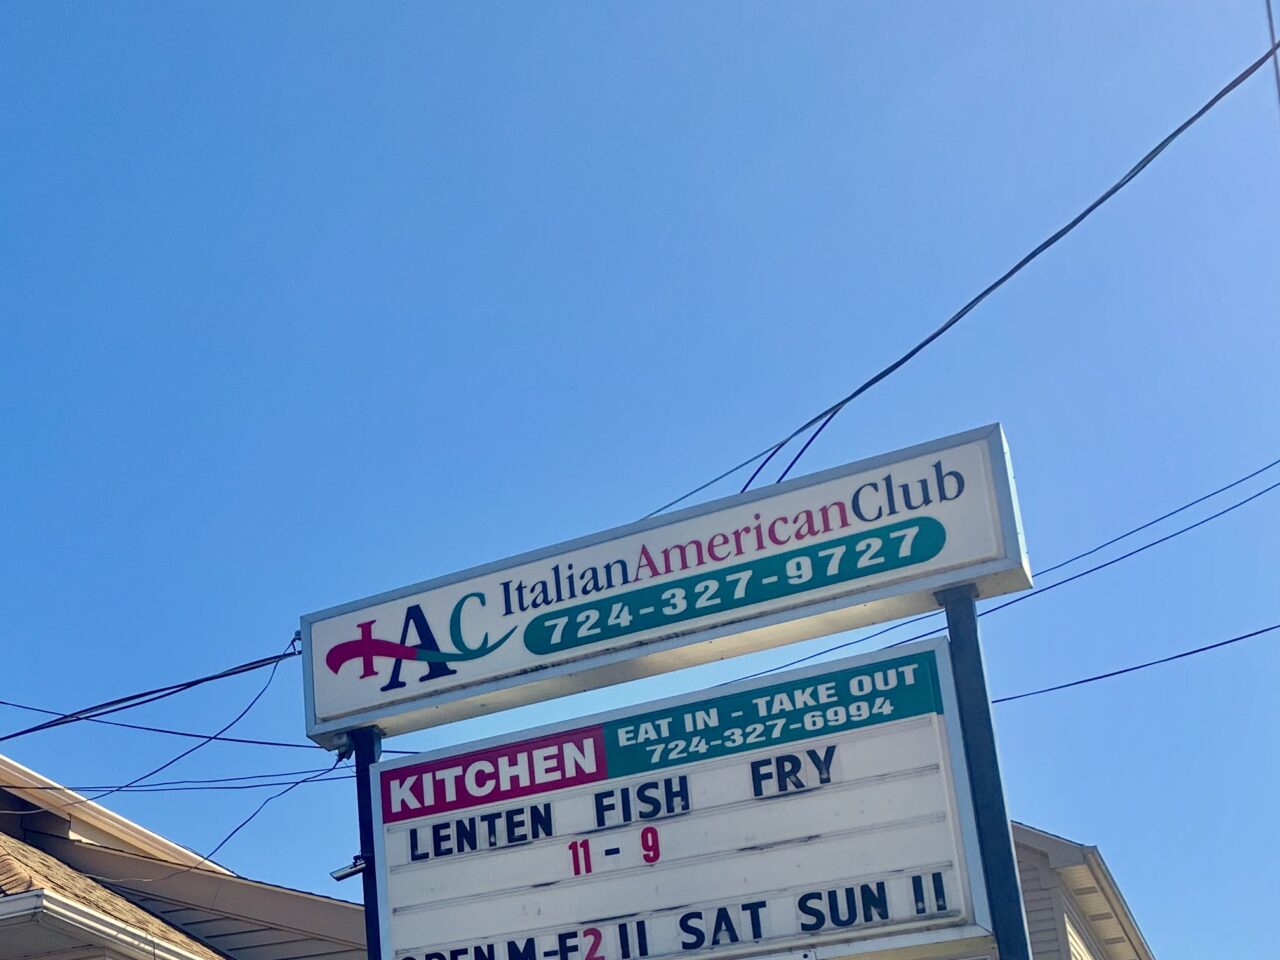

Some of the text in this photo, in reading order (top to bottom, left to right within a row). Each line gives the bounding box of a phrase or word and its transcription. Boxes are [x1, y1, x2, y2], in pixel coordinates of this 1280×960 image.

[543, 526, 920, 645] 724-327-9727
[617, 719, 673, 748] EAT
[685, 709, 719, 735] IN
[753, 683, 836, 718] TAKE
[849, 664, 920, 696] OUT
[646, 697, 895, 765] 724-327-6994
[389, 738, 598, 813] KITCHEN
[410, 745, 837, 862] LENTEN FISH FRY
[568, 839, 592, 876] 11
[641, 827, 661, 863] 9
[679, 900, 767, 950] SAT
[798, 881, 889, 931] SUN
